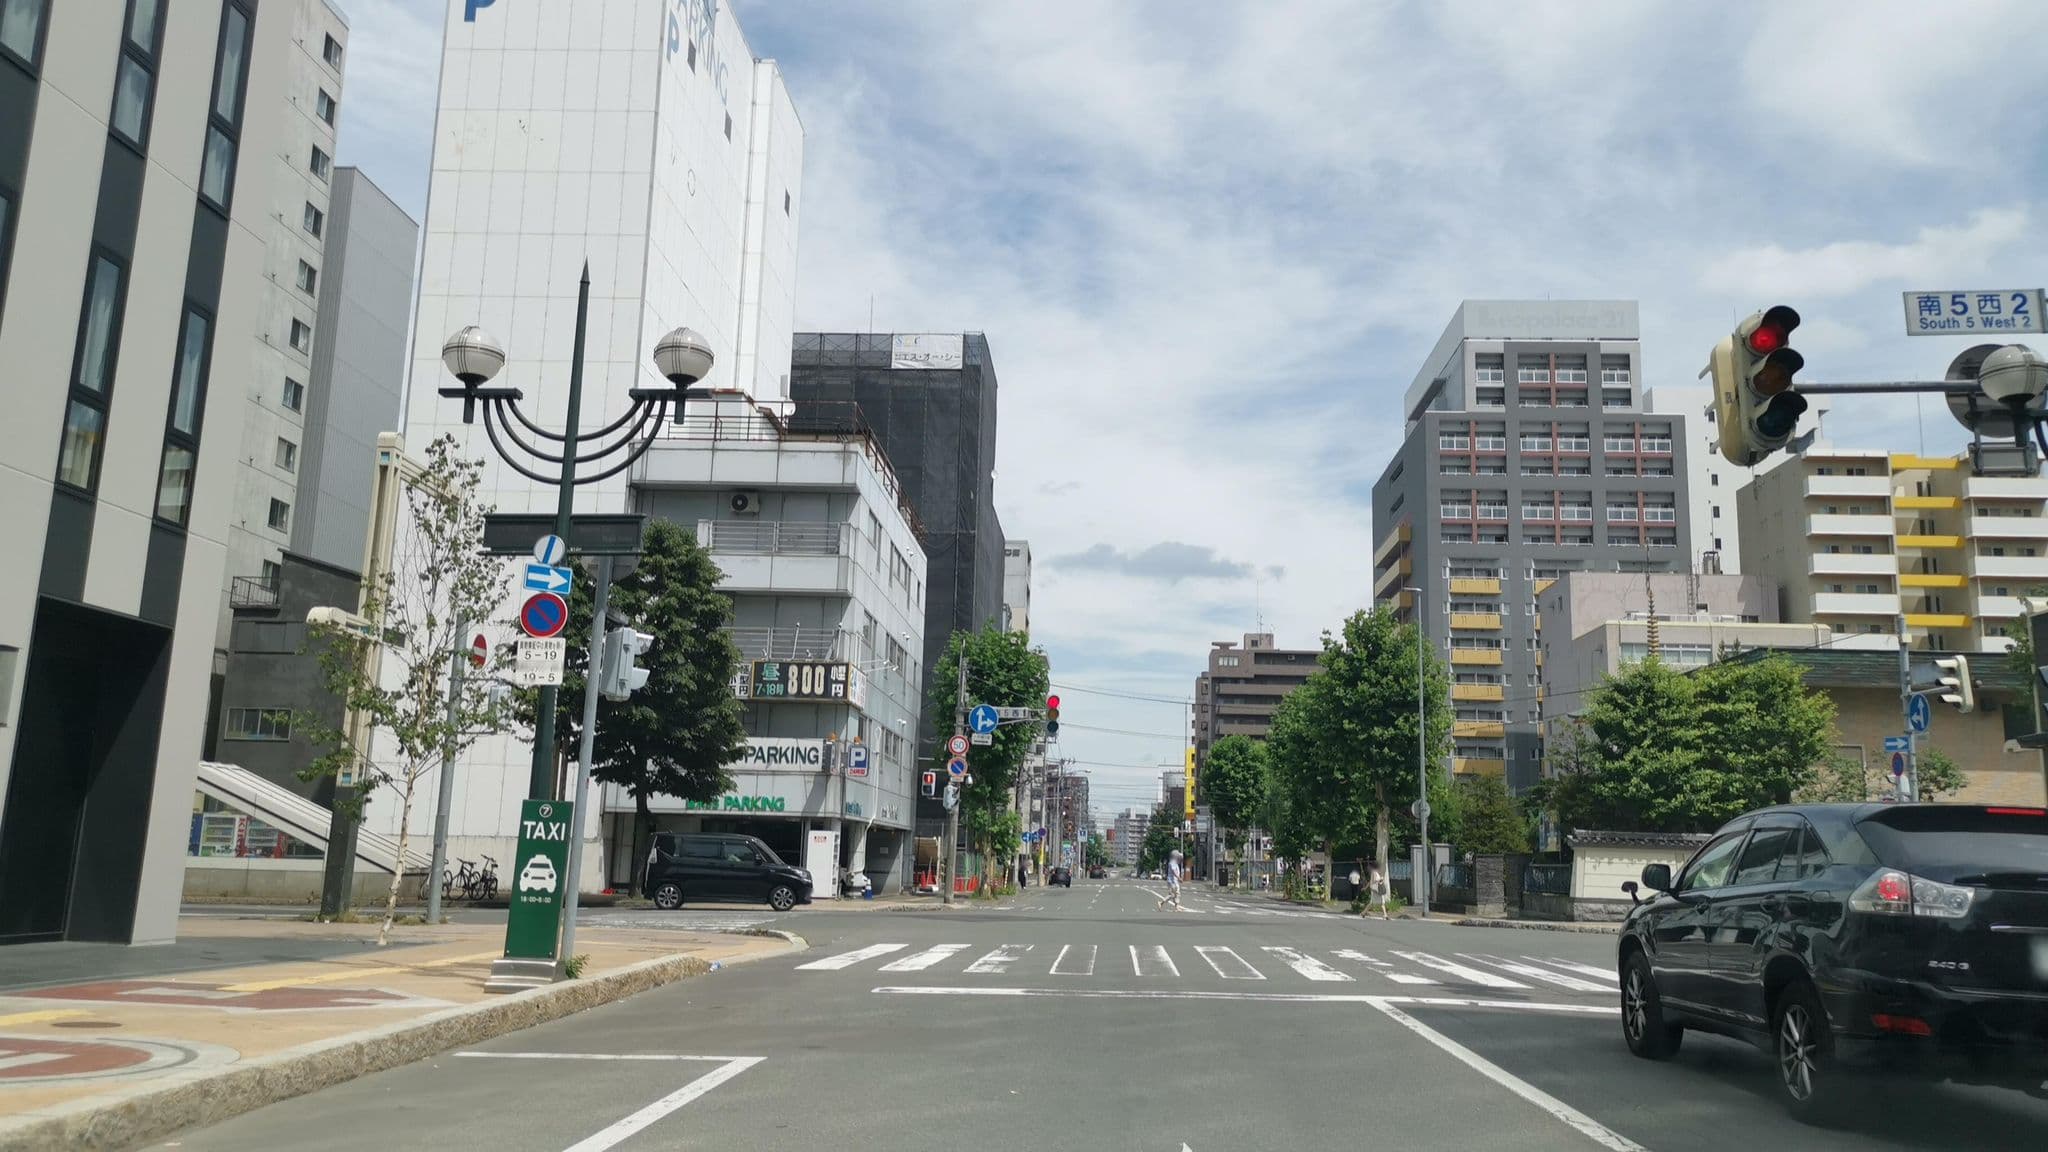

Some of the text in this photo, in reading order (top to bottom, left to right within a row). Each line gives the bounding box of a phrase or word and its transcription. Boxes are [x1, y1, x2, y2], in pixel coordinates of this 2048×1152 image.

[667, 9, 680, 64] P
[1916, 292, 2029, 316] 南5西2
[1919, 315, 2031, 330] South 5 West 2
[762, 663, 780, 681] 昼
[787, 664, 825, 696] 800
[831, 683, 844, 698] 円
[954, 741, 965, 749] 50
[745, 745, 819, 766] PARKING
[849, 747, 866, 767] P
[541, 806, 550, 816] 7
[724, 796, 785, 812] PARKING
[523, 820, 566, 841] TAXI
